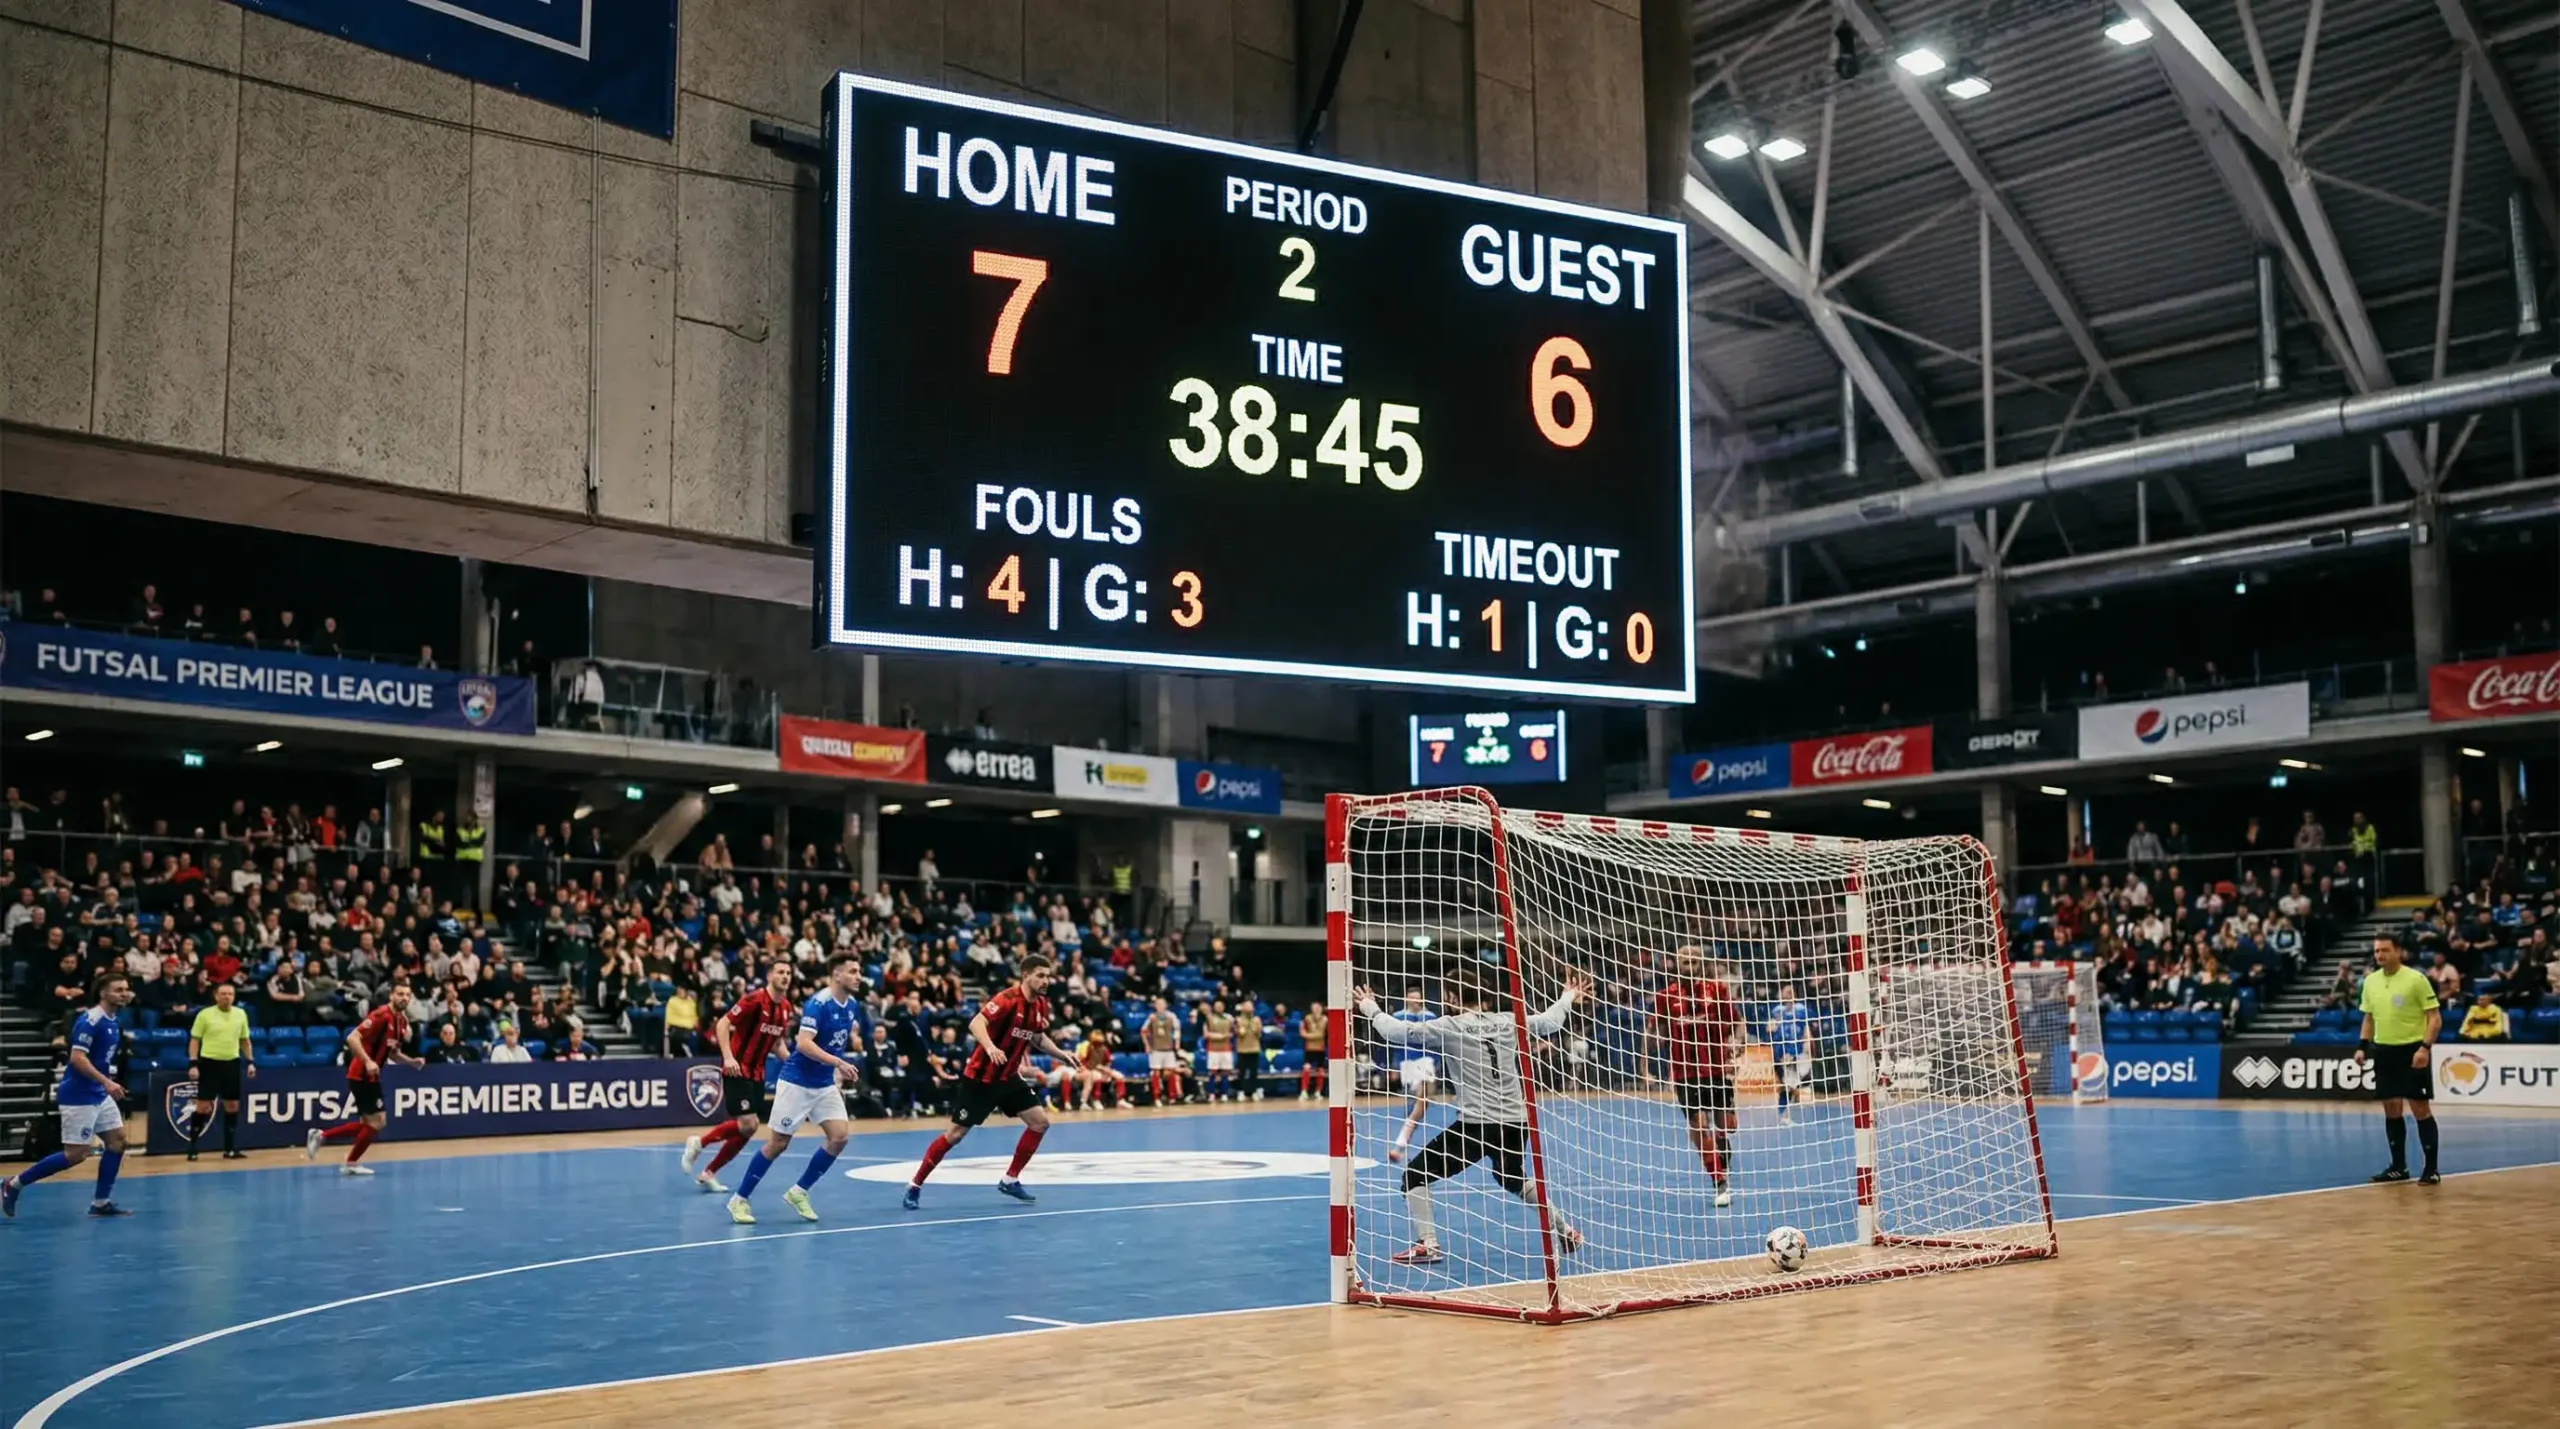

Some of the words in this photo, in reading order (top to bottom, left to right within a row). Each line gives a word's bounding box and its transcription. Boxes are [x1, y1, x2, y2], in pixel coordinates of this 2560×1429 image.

[905, 126, 1116, 225] HOME
[1226, 176, 1368, 236] PERIOD
[1279, 236, 1316, 302] 2
[1461, 223, 1656, 310] GUEST
[973, 250, 1048, 375] 7
[1252, 333, 1344, 385] TIME
[1531, 336, 1594, 448] 6
[1169, 377, 1424, 490] 38:45
[976, 483, 1142, 545] FOULS
[898, 544, 964, 609] H:
[988, 554, 1026, 614] 4
[1084, 562, 1148, 624] G:
[1172, 570, 1203, 628] 3
[1434, 531, 1620, 592] TIMEOUT
[1407, 591, 1460, 649] H:
[1481, 599, 1503, 652] 1
[1556, 605, 1609, 661] G:
[1626, 612, 1654, 664] 0
[38, 644, 168, 681] FUTSAL
[177, 660, 313, 697] PREMIER
[322, 674, 433, 709] LEAGUE
[2174, 703, 2245, 738] pepsi
[975, 749, 1036, 783] errea
[1429, 741, 1447, 763] 7
[1717, 757, 1768, 783] pepsi
[1813, 734, 1907, 778] Coca-Cola
[1219, 778, 1261, 800] pepsi
[247, 1090, 358, 1124] FUTSA
[394, 1083, 543, 1117] PREMIER
[550, 1079, 668, 1111] LEAGUE
[2113, 1056, 2194, 1087] pepsi
[2500, 1066, 2559, 1087] FUT
